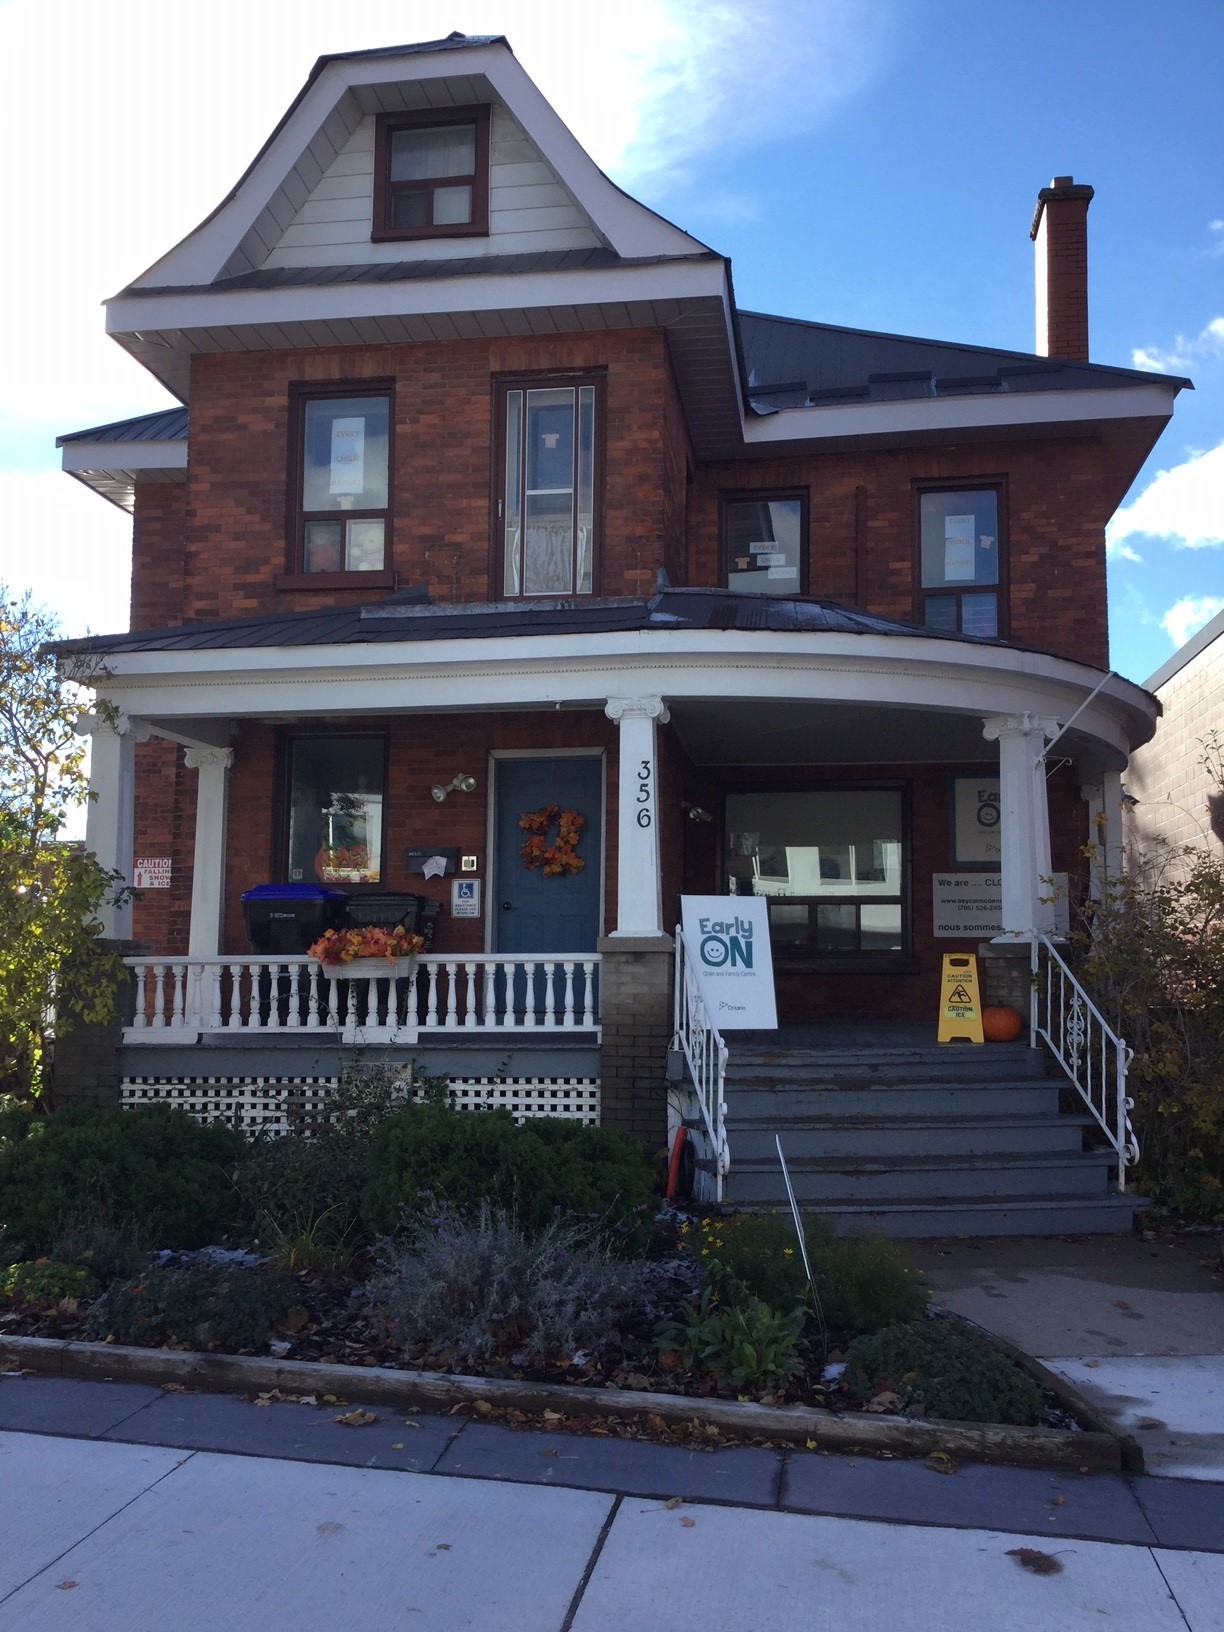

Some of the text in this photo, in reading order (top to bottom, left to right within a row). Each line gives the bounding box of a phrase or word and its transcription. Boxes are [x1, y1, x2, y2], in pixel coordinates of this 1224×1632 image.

[636, 760, 652, 829] 356
[937, 878, 952, 887] We
[954, 879, 969, 887] are
[698, 915, 754, 940] Early
[963, 924, 1002, 932] sommes
[699, 934, 754, 969] ON
